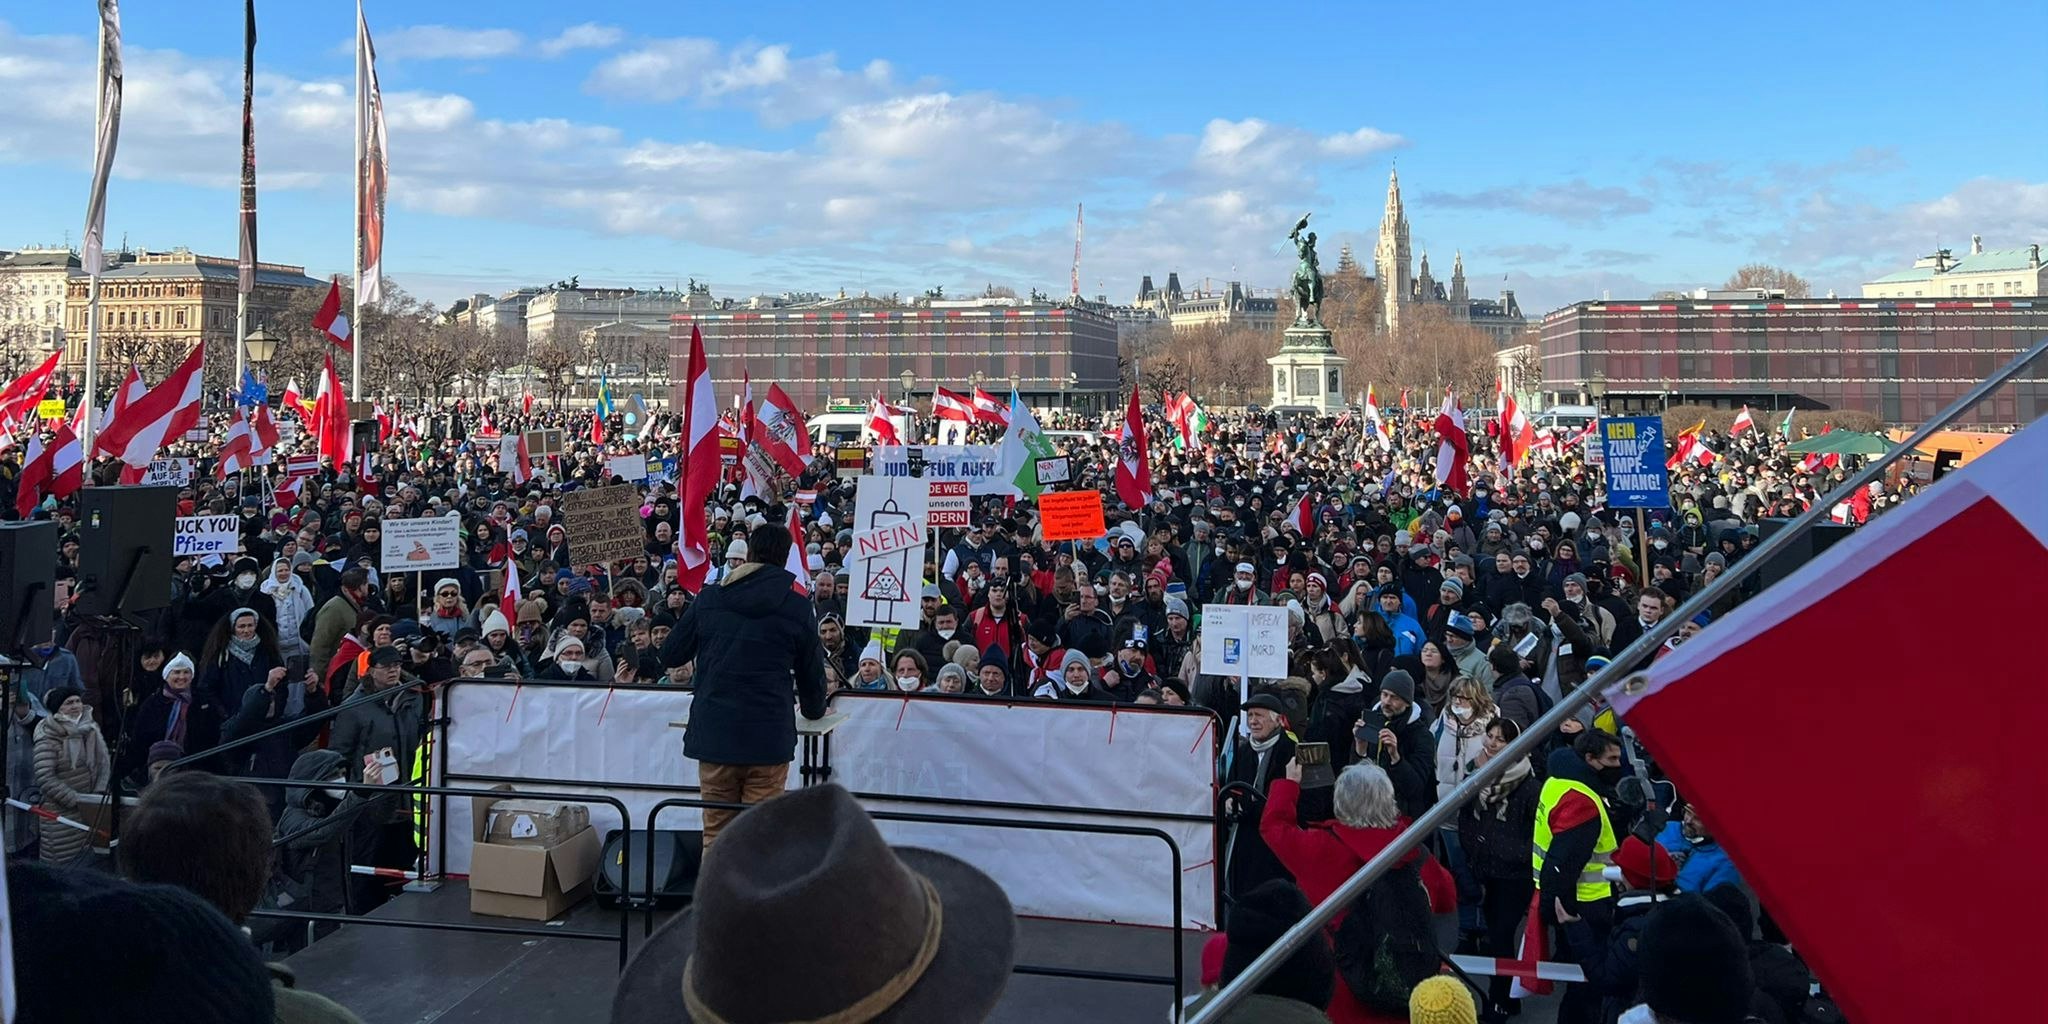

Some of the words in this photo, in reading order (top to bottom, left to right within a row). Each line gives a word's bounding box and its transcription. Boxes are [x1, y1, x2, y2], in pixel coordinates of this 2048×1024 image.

[1607, 422, 1636, 439] NEIN
[1608, 440, 1637, 456] ZUM
[148, 462, 166, 472] WIR
[930, 460, 955, 476] FÜR
[961, 462, 995, 476] AUFK
[1610, 457, 1648, 474] IMPF-
[151, 472, 168, 481] AUF
[169, 472, 182, 480] DIE
[1040, 472, 1050, 481] JA
[1612, 474, 1661, 491] ZWANG!
[930, 484, 941, 494] DE
[944, 484, 966, 494] WEG
[176, 520, 204, 534] UCK
[209, 517, 237, 532] YOU
[176, 536, 222, 553] Pfizer
[859, 522, 919, 555] NEIN
[1250, 644, 1275, 656] MORD
